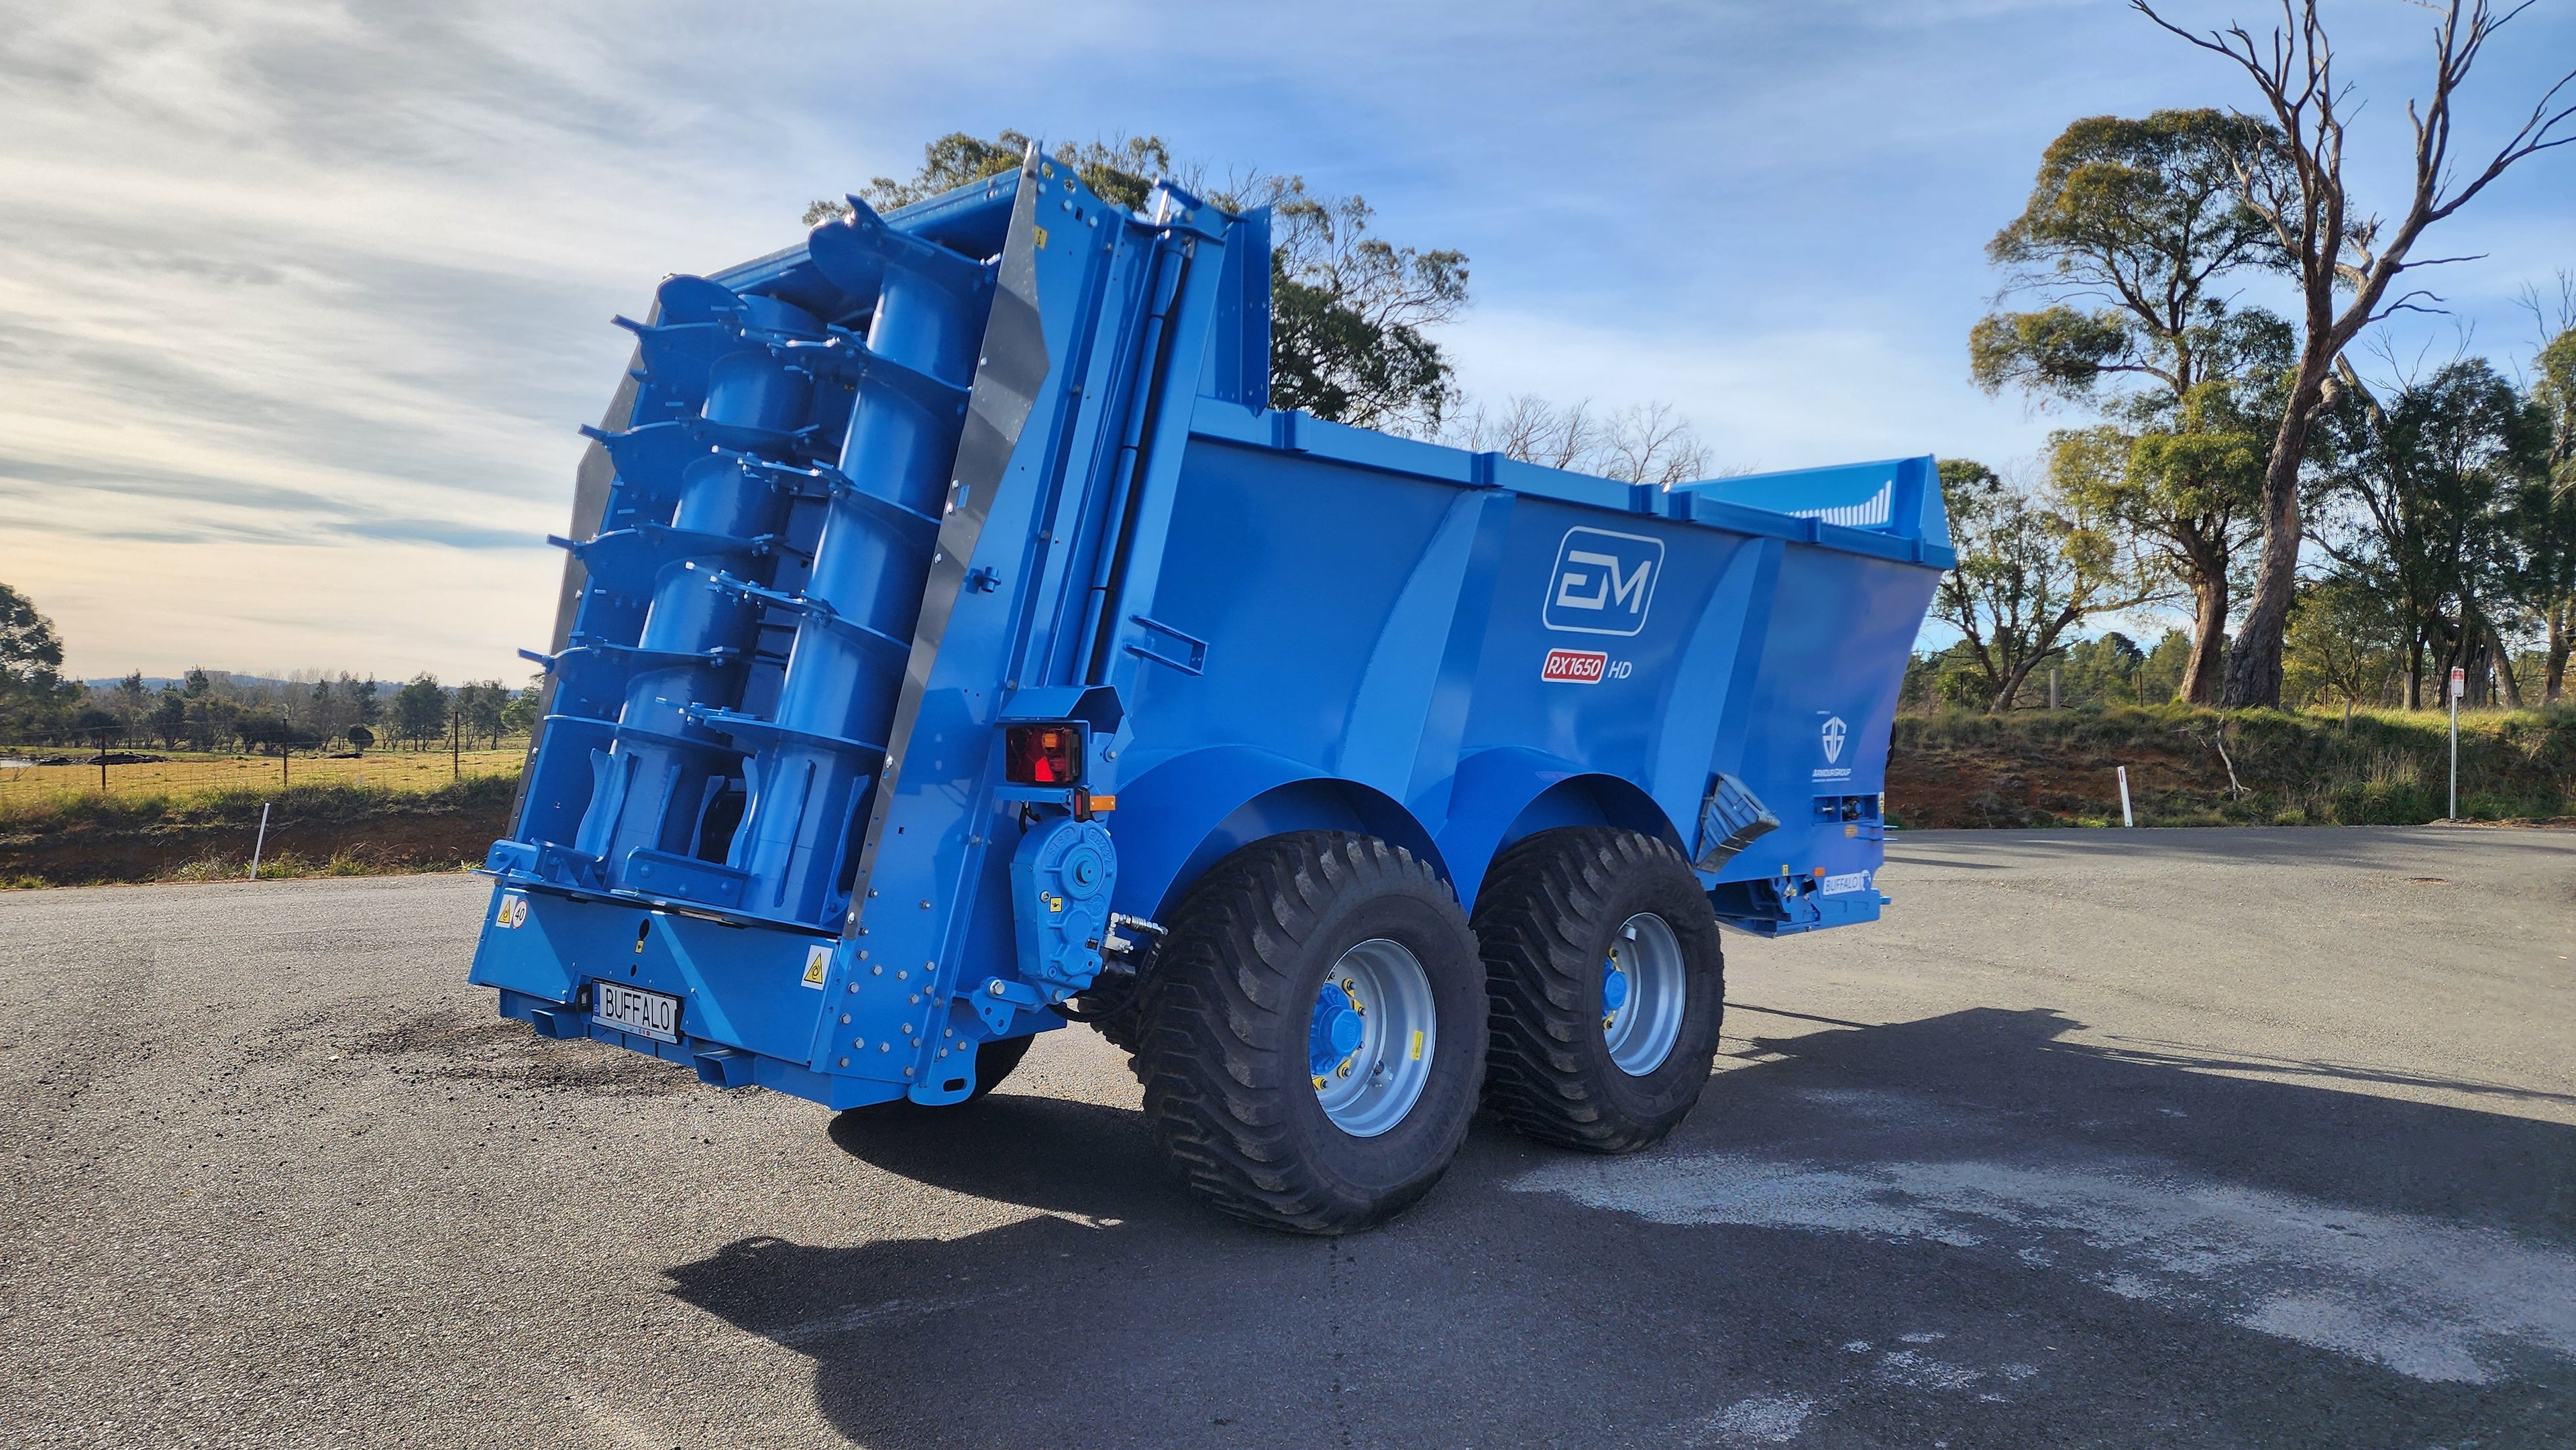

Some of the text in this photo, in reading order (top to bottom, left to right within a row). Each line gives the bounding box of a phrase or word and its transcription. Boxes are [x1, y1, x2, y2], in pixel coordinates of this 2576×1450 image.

[1556, 550, 1652, 614] EM
[1547, 656, 1632, 679] RX1650 HD
[1825, 877, 1858, 892] BUFFALO
[515, 907, 525, 921] 40
[606, 988, 669, 1031] BUFFALO
